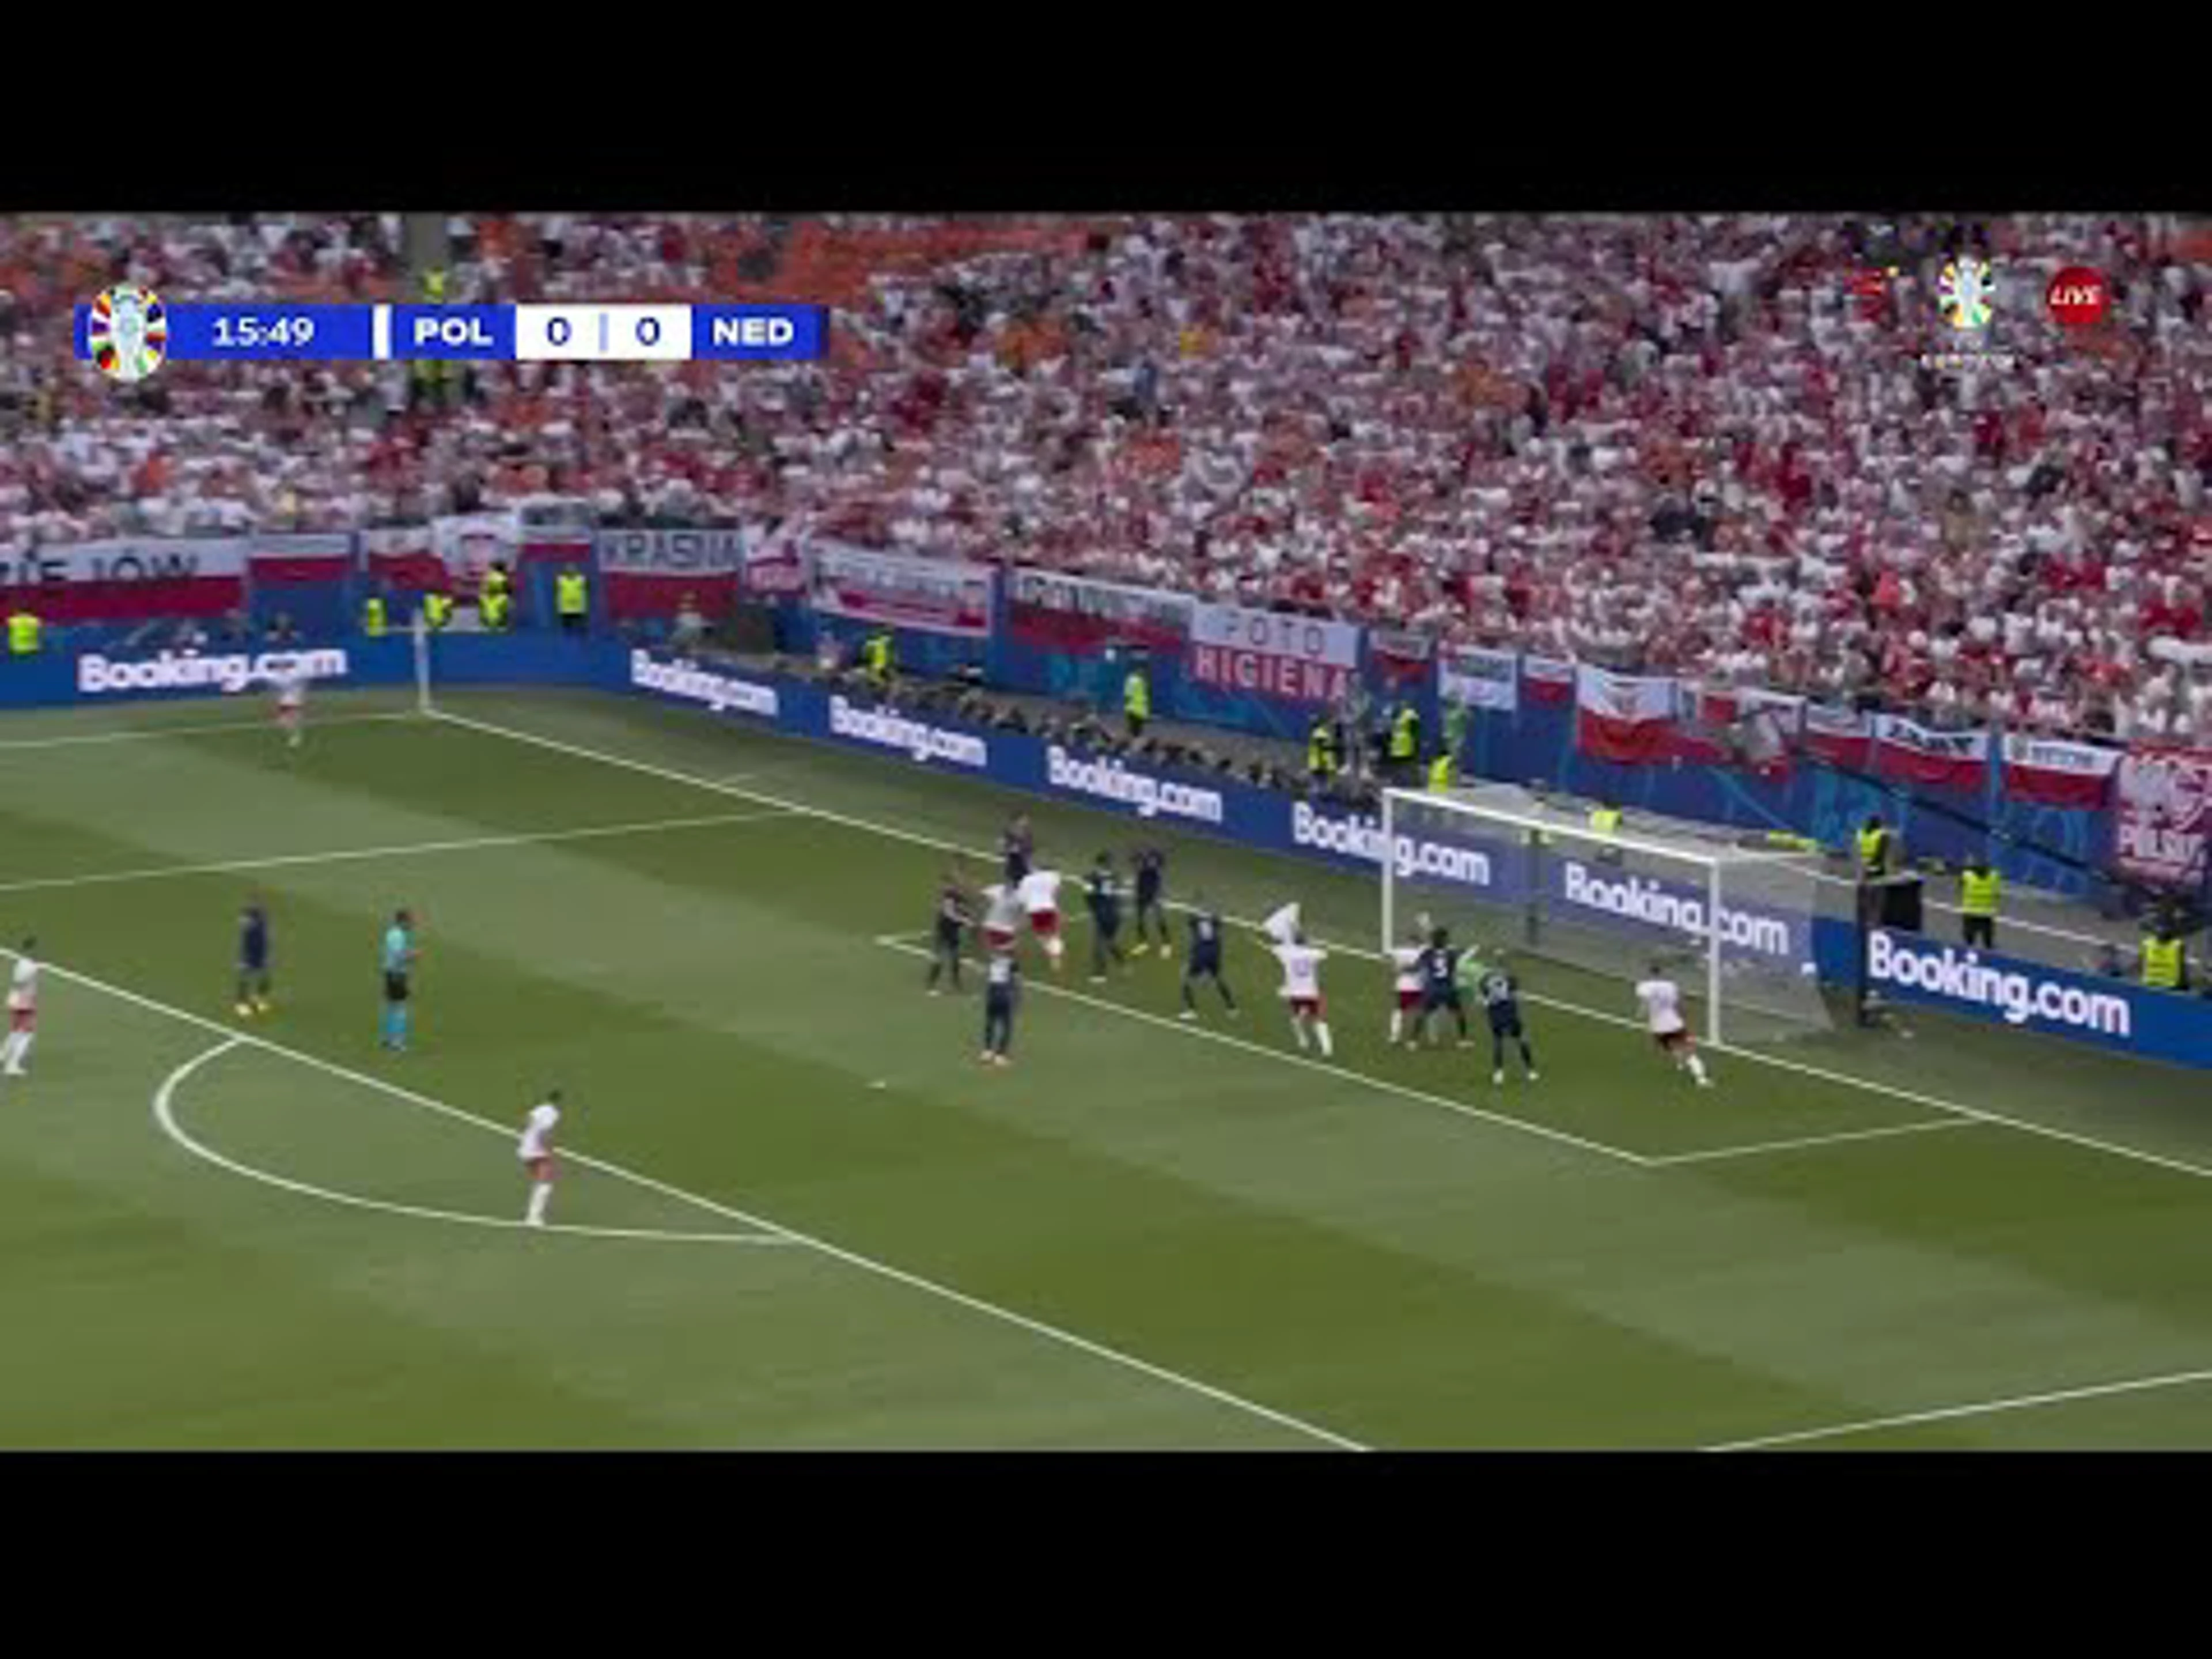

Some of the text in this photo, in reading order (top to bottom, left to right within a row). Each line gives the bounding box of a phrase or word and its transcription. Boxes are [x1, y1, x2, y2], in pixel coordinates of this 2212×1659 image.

[78, 649, 348, 692] Booking.com
[631, 649, 779, 716] Booking.com
[829, 695, 987, 767] Booking.com
[1047, 745, 1222, 822] Booking.com
[1293, 801, 1490, 887] Booking.com
[1869, 931, 2131, 1036] Booking.com
